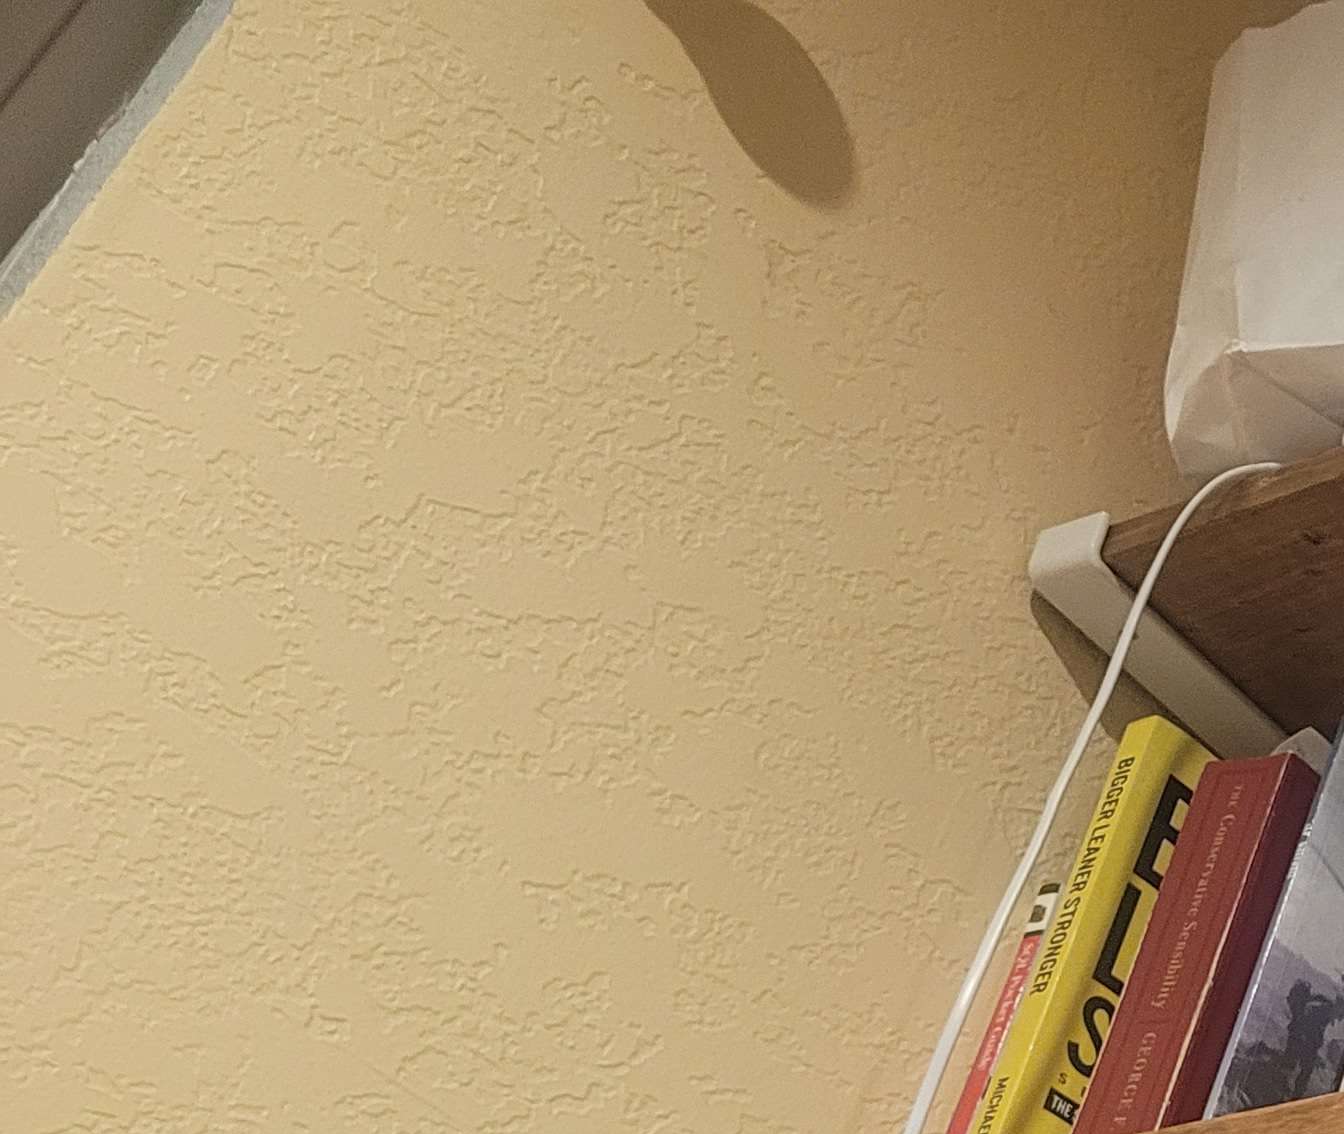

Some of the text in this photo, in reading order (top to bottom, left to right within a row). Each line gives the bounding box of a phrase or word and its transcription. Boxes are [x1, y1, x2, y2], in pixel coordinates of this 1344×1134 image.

[1097, 756, 1134, 823] BIGGER
[1066, 824, 1109, 891] LEANER
[1153, 811, 1238, 1010] Conservative Sensibility
[1031, 896, 1080, 995] STRONGER
[1051, 1095, 1073, 1118] THE
